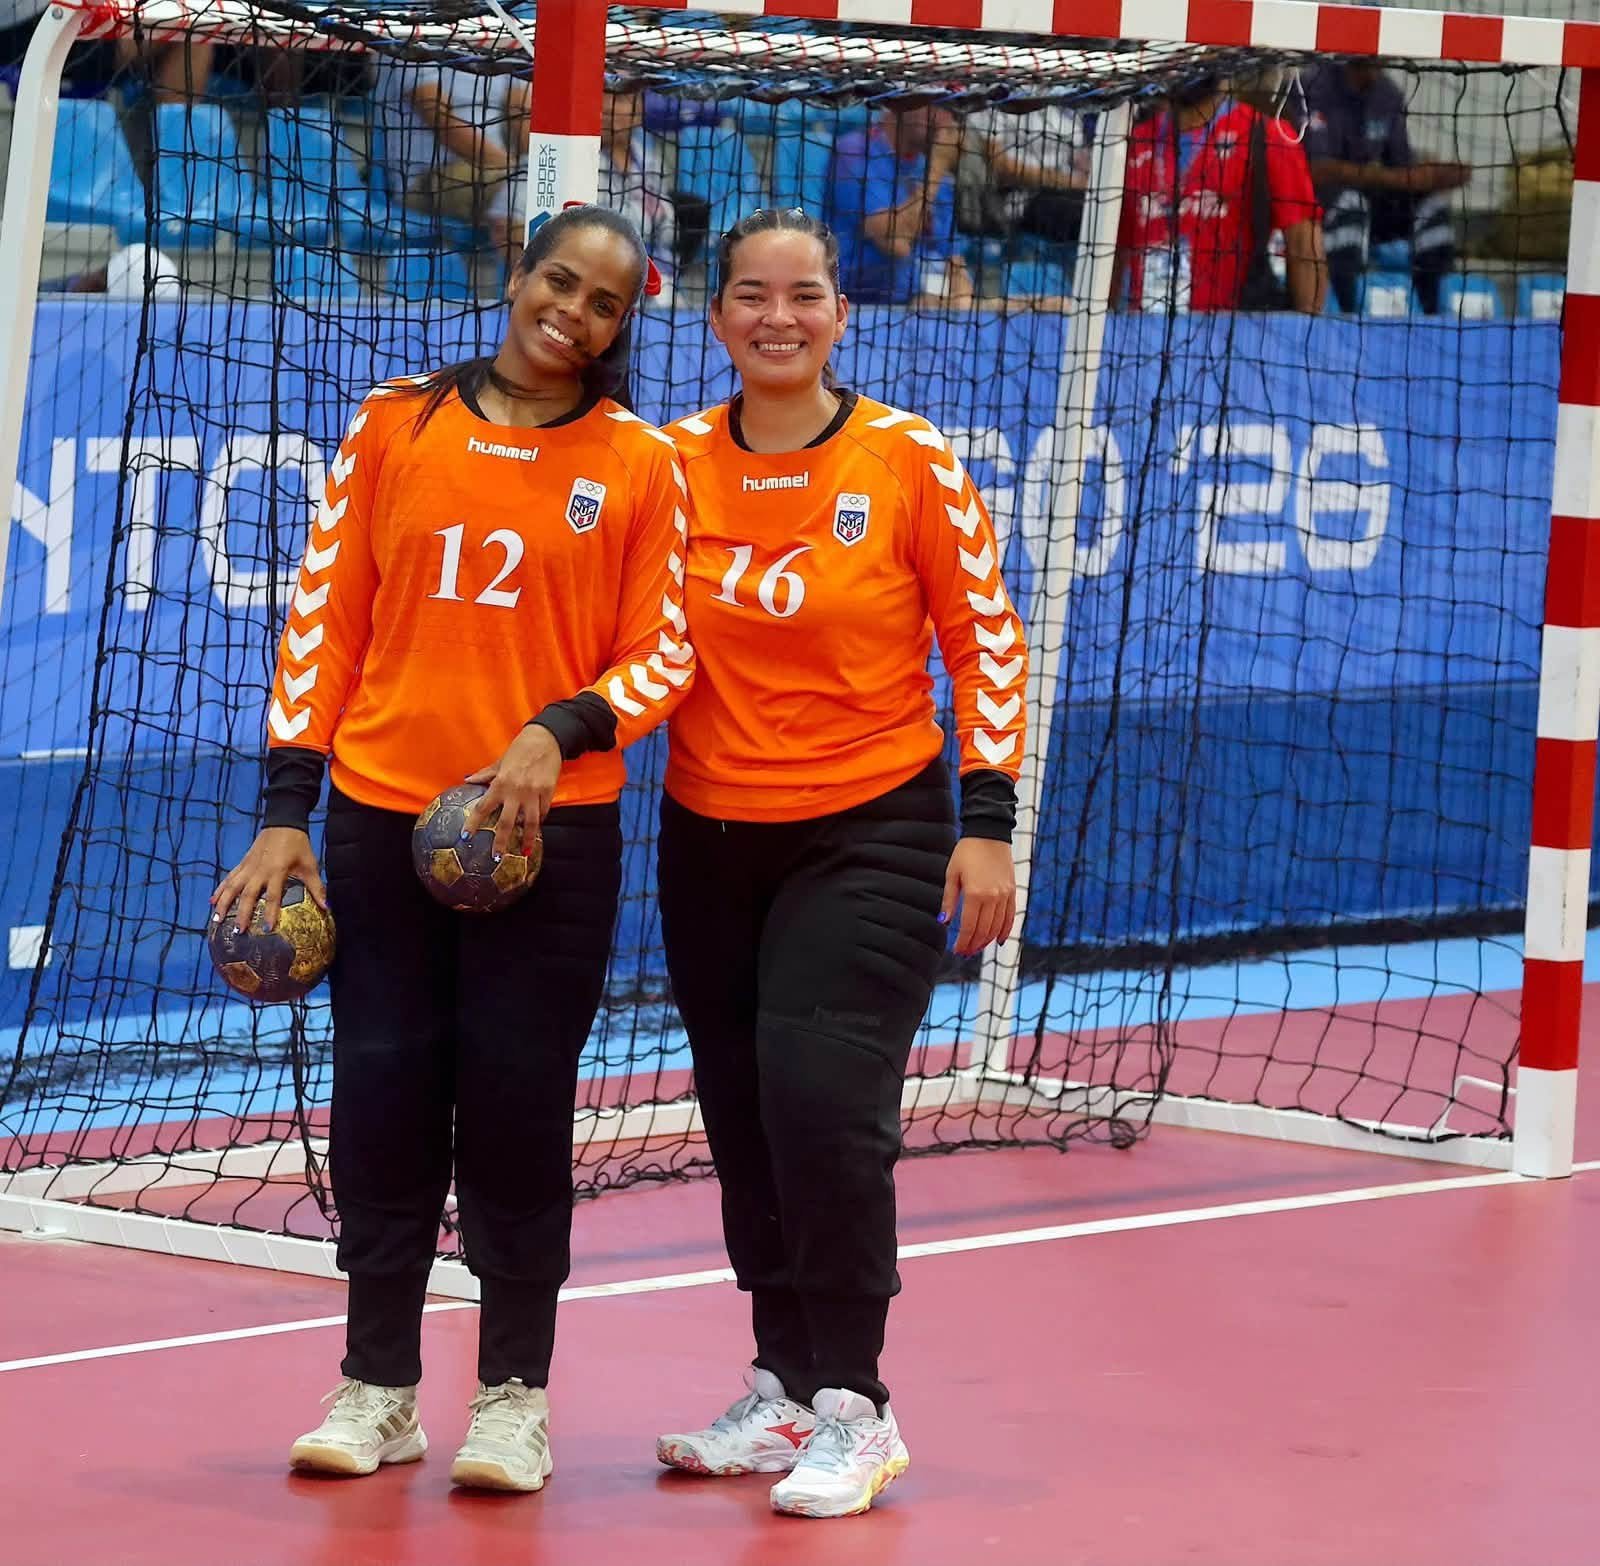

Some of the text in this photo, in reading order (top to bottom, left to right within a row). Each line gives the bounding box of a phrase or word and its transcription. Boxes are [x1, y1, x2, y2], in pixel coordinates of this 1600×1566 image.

[537, 144, 548, 207] SODEX
[546, 144, 557, 208] SPORT
[467, 436, 539, 462] hummel
[742, 471, 809, 492] hummel
[427, 523, 525, 608] 12
[710, 545, 813, 618] 16
